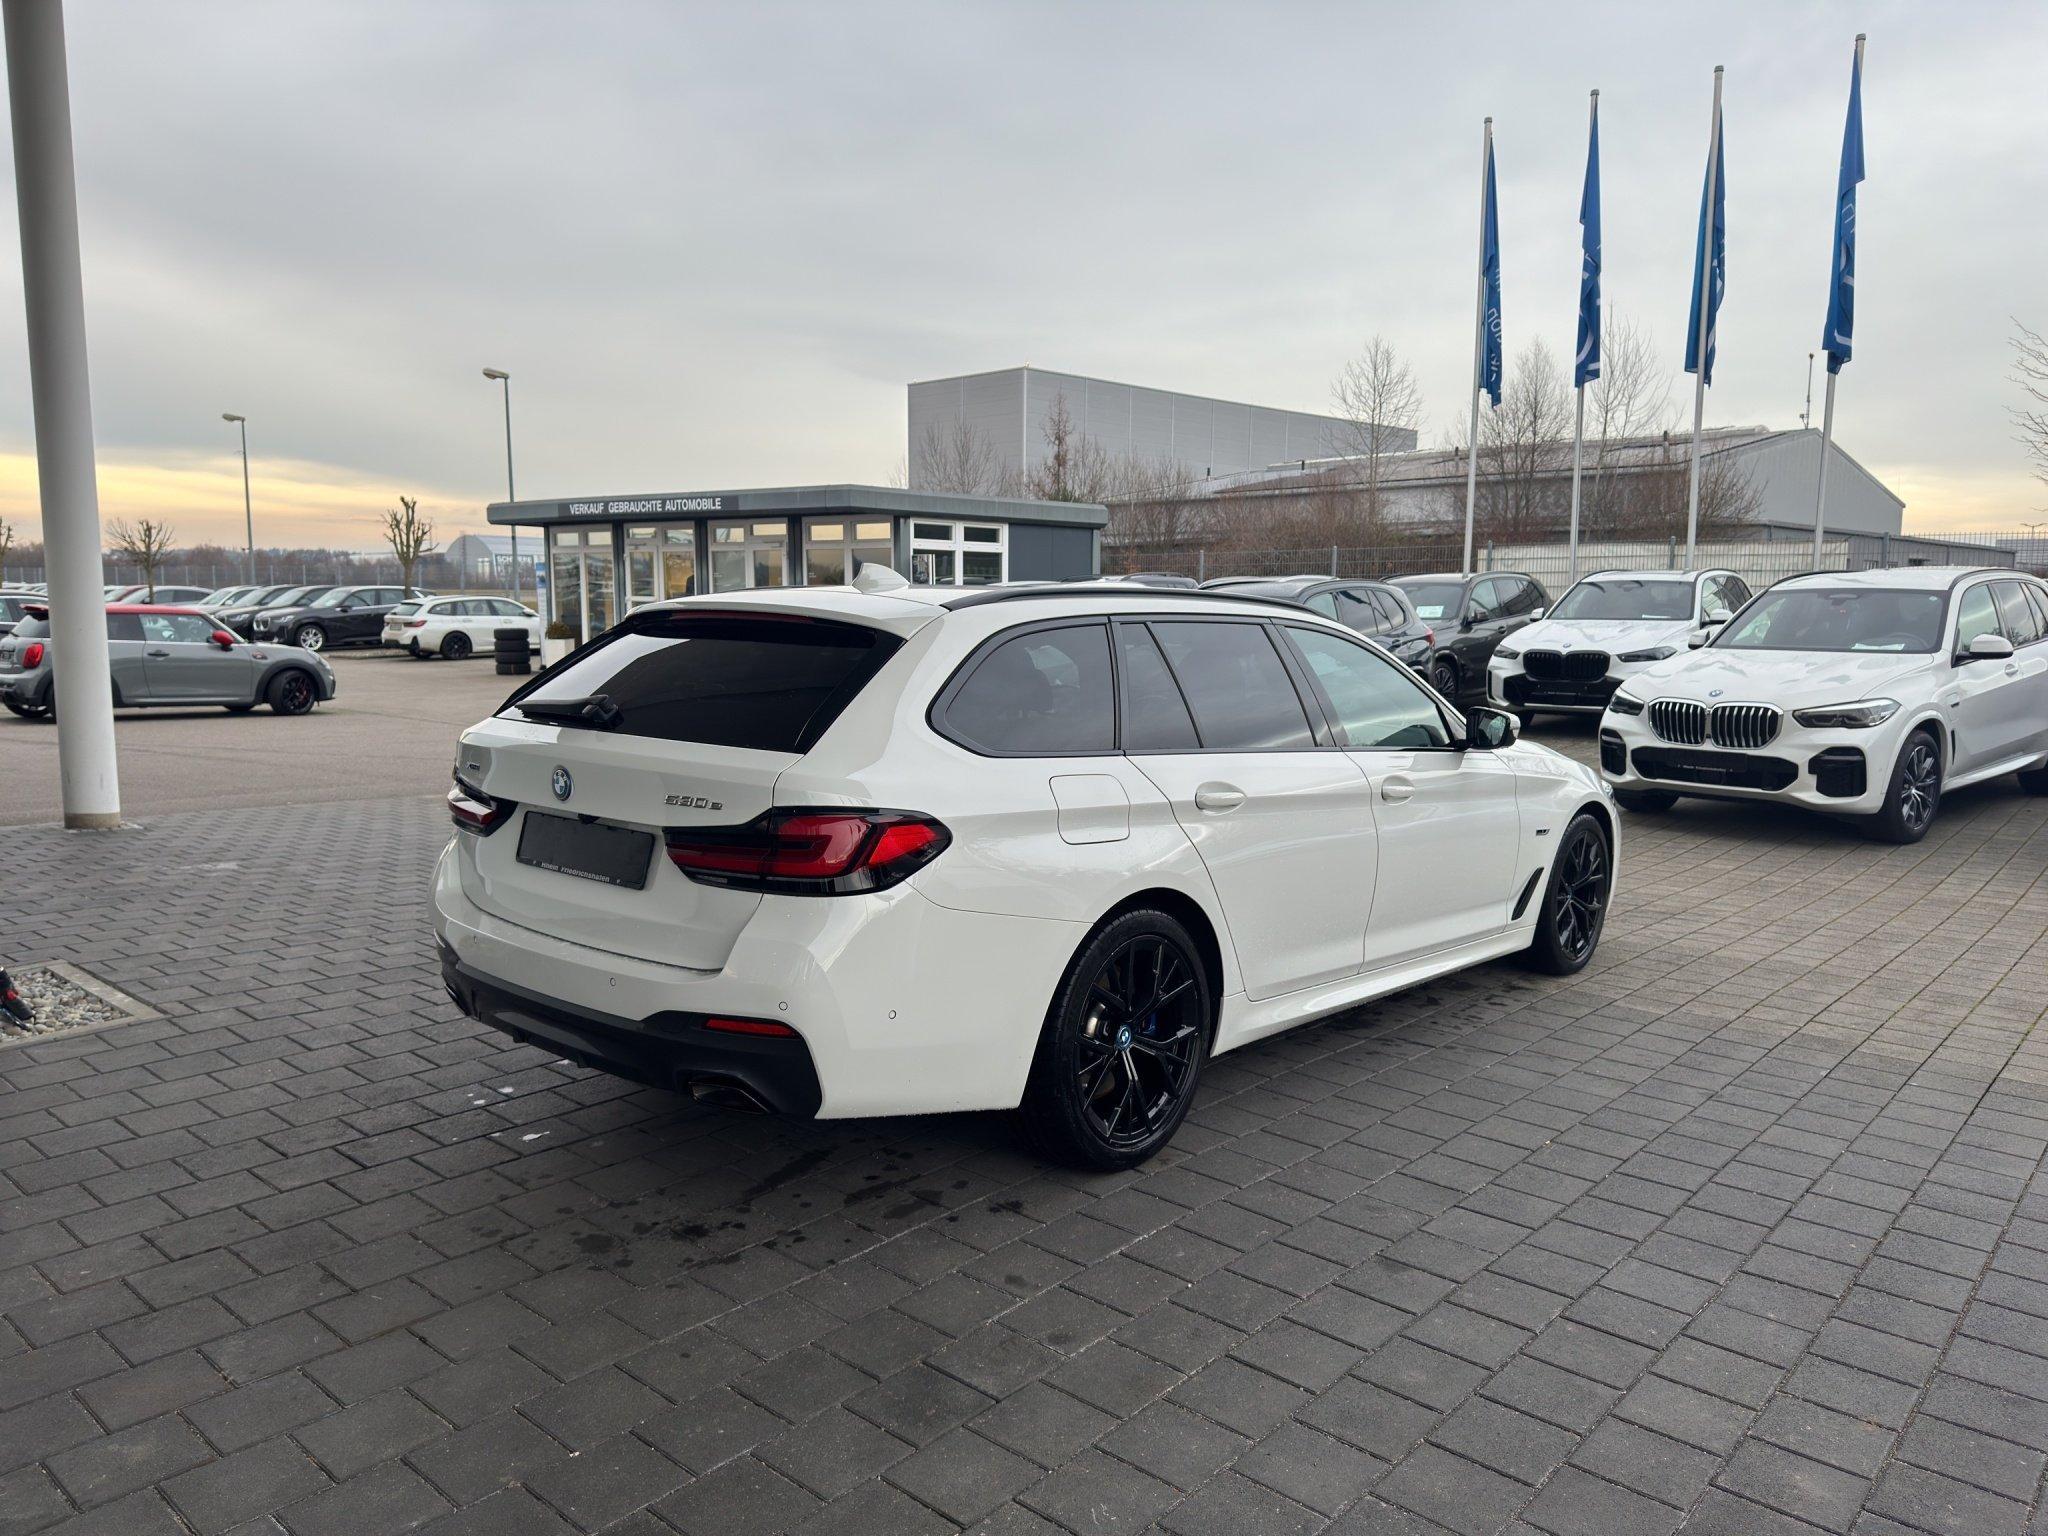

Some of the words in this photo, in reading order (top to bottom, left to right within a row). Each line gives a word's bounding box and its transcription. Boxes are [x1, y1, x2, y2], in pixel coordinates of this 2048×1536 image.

[569, 503, 604, 515] VERKAUF
[608, 500, 662, 513] GEBRAUCHTE
[665, 498, 721, 511] AUTOMOBILE
